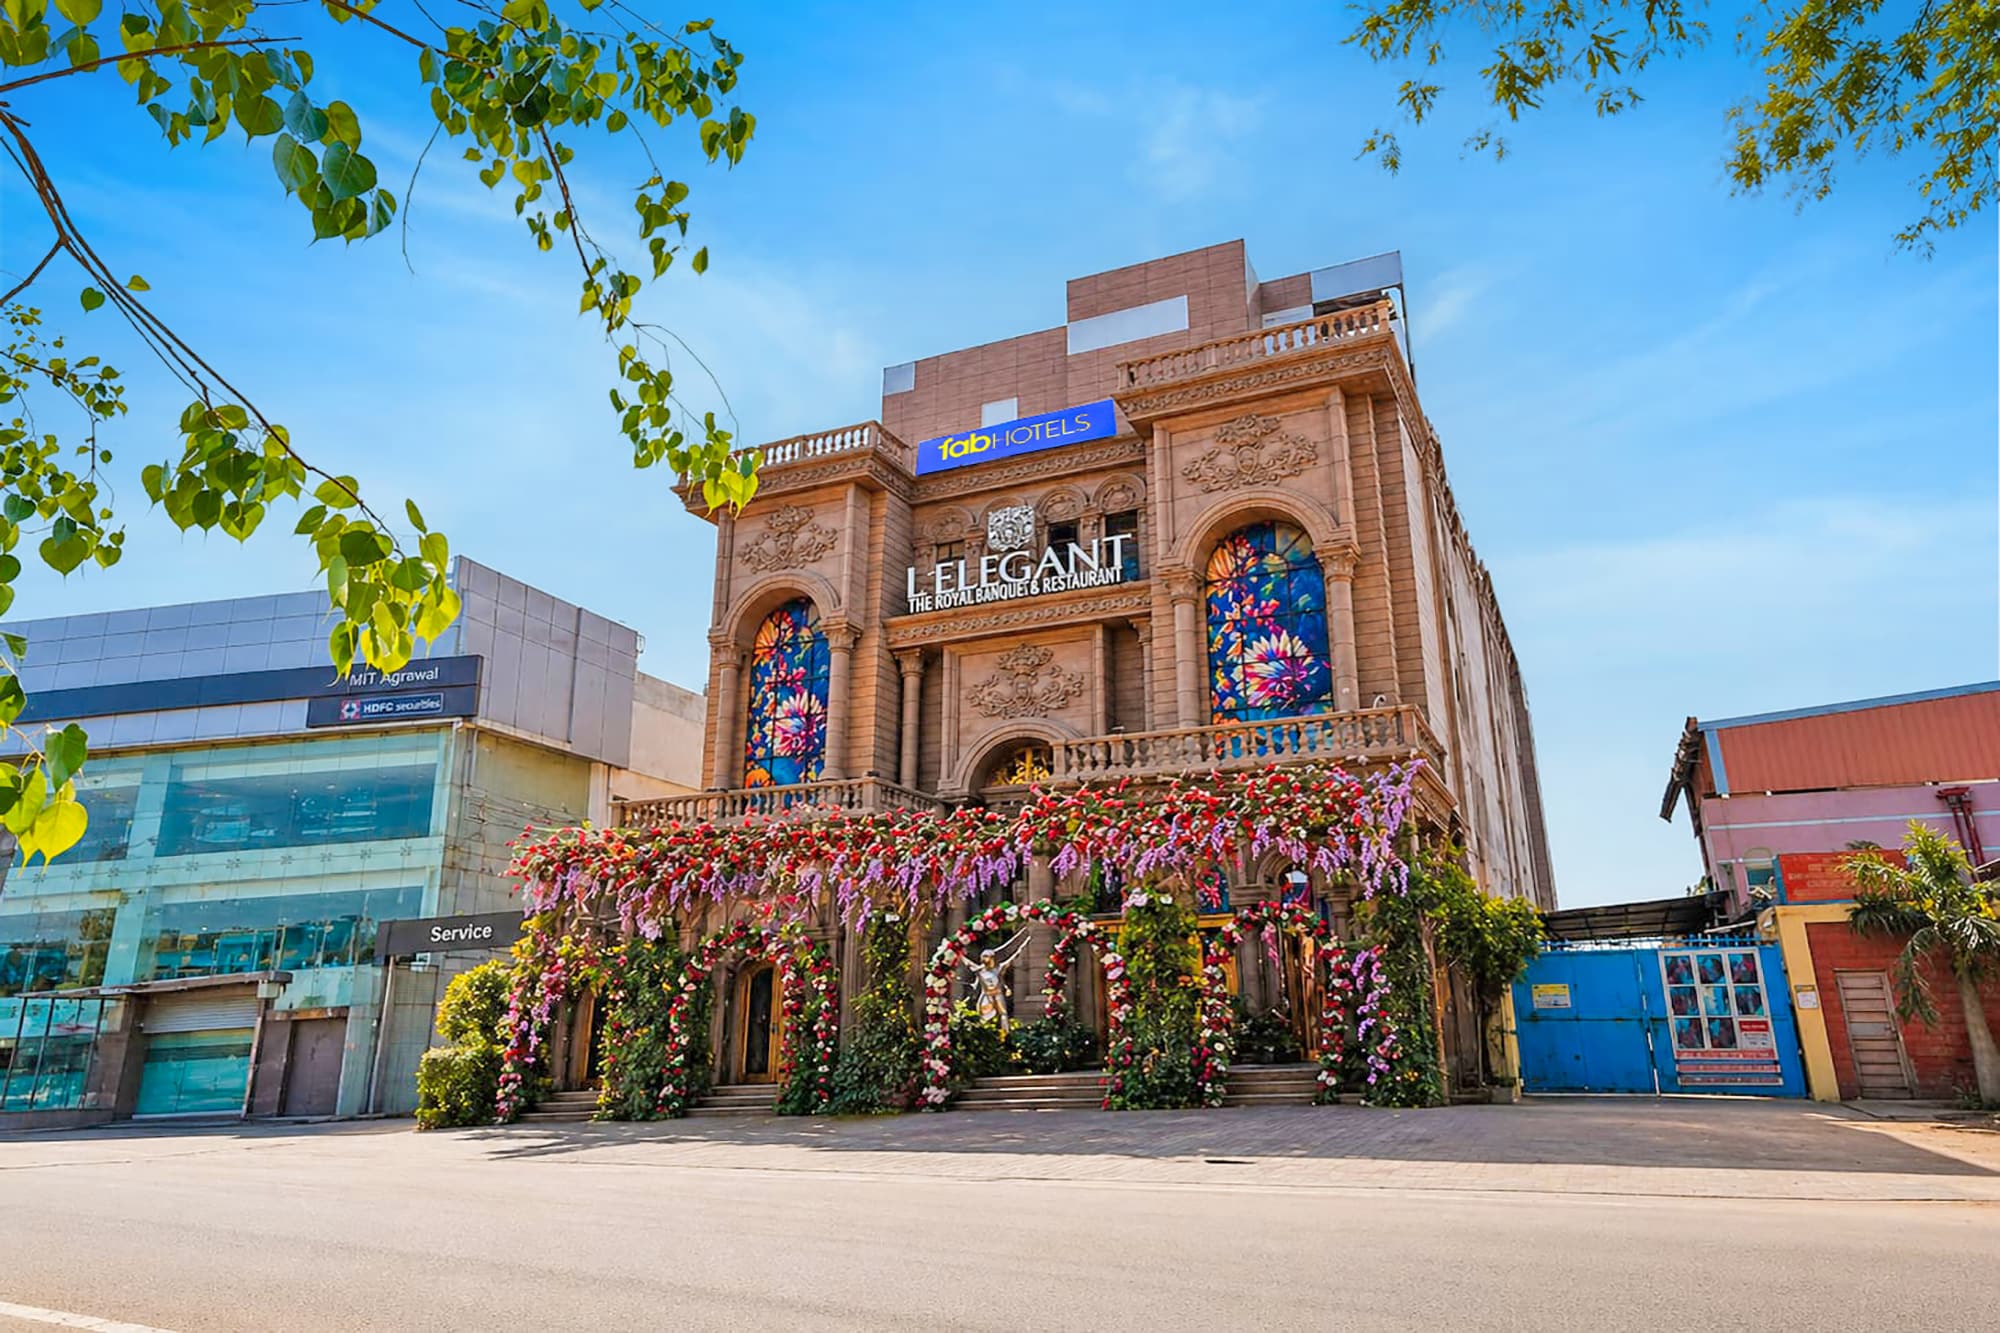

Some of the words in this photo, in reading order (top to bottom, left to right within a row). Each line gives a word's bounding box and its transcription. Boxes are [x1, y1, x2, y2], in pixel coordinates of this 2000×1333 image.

[938, 413, 1091, 460] fabHOTELS
[908, 596, 933, 614] THE
[935, 589, 975, 610] ROYAL
[975, 581, 1029, 604] BANQUET
[1030, 580, 1040, 595] &
[1043, 567, 1123, 593] RESTAURANT
[380, 666, 439, 687] Agrawal
[363, 702, 394, 713] HDFC
[430, 923, 493, 942] Service
